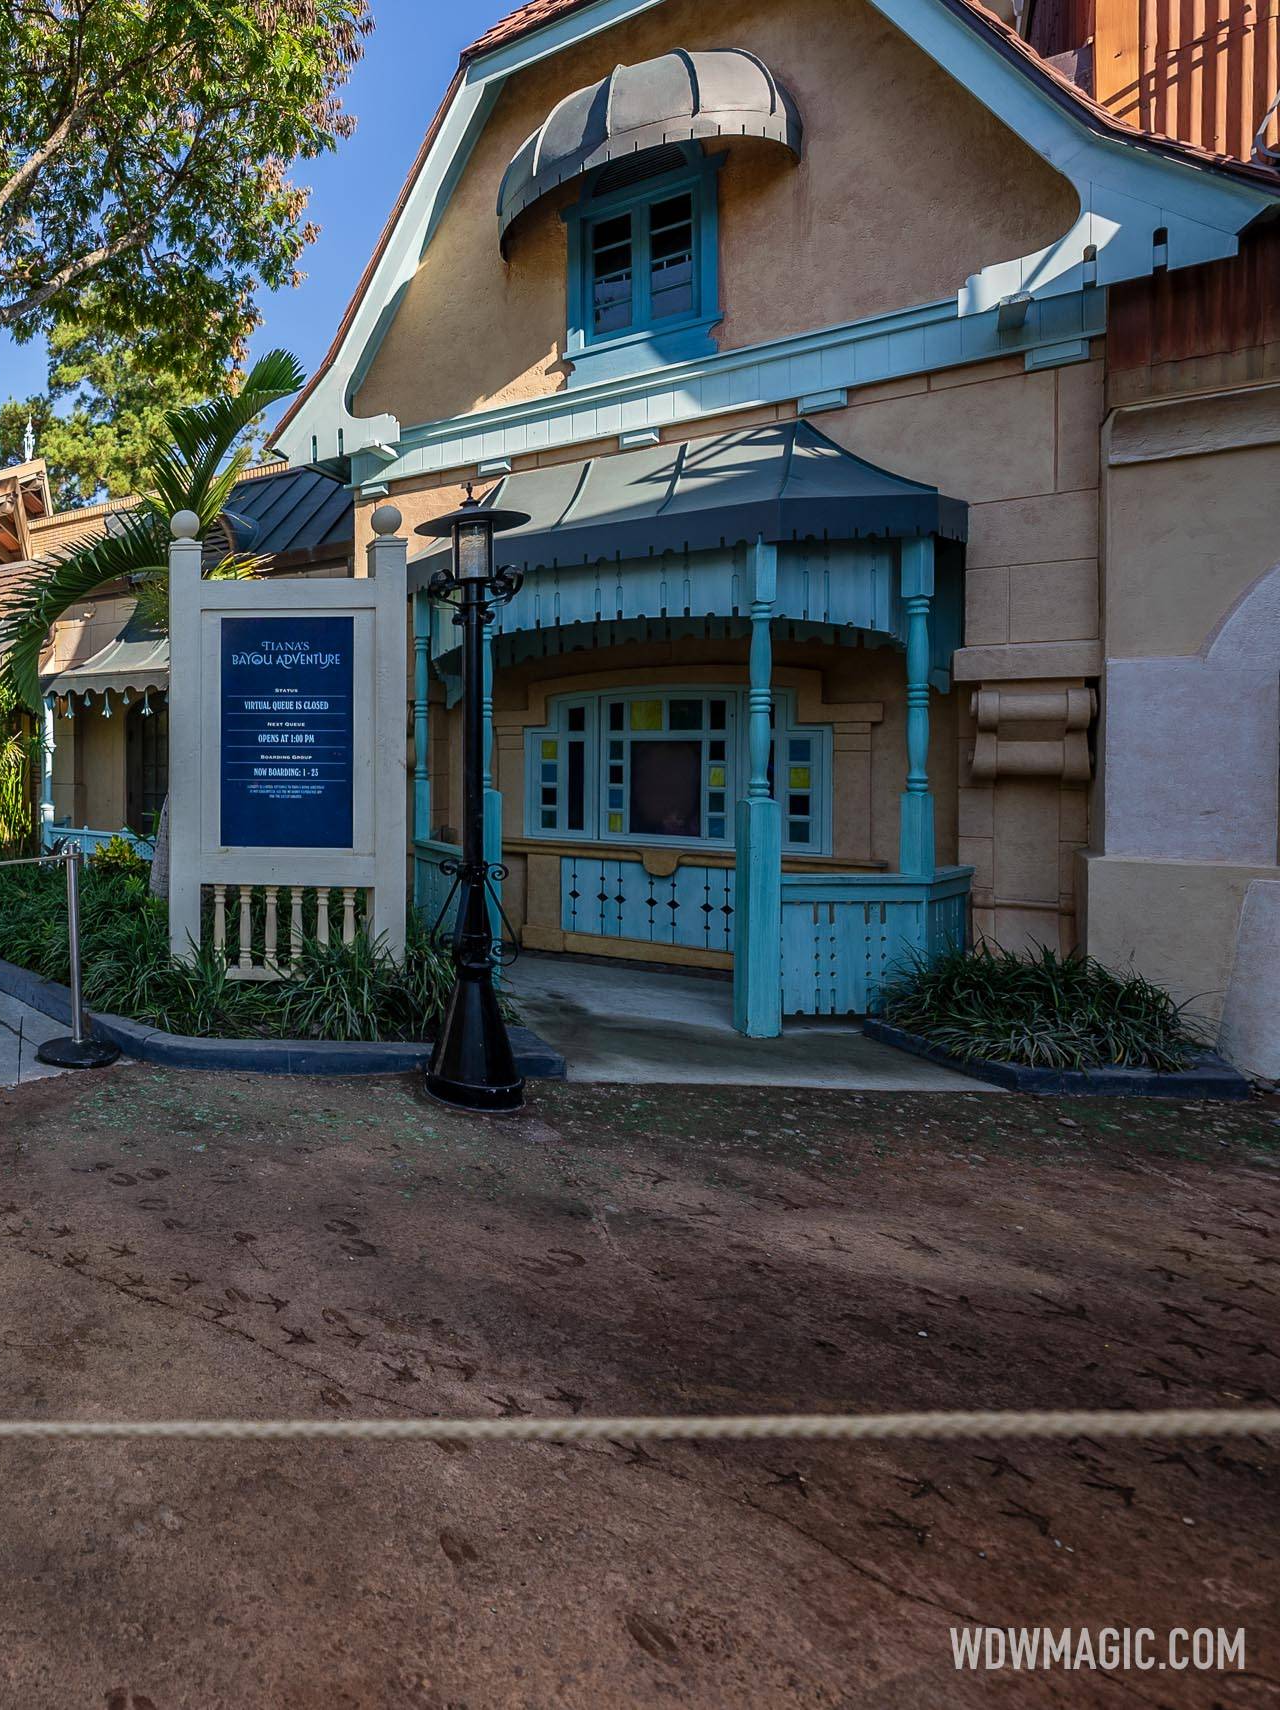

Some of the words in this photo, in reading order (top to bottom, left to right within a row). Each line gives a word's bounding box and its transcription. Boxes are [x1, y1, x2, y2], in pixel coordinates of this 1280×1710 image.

[262, 641, 309, 651] TIANA'S
[232, 652, 272, 665] BAYOU
[276, 652, 340, 669] ADVENTURE
[245, 700, 271, 710] VIRTUAL
[272, 701, 294, 712] QUEUE
[296, 700, 302, 710] IS
[304, 700, 328, 710] CLOSED
[258, 733, 279, 743] OPENS
[281, 733, 289, 743] AT
[291, 734, 303, 744] 1:00
[305, 734, 314, 744] PM
[254, 767, 267, 777] NOW
[269, 767, 301, 777] BOARDING:
